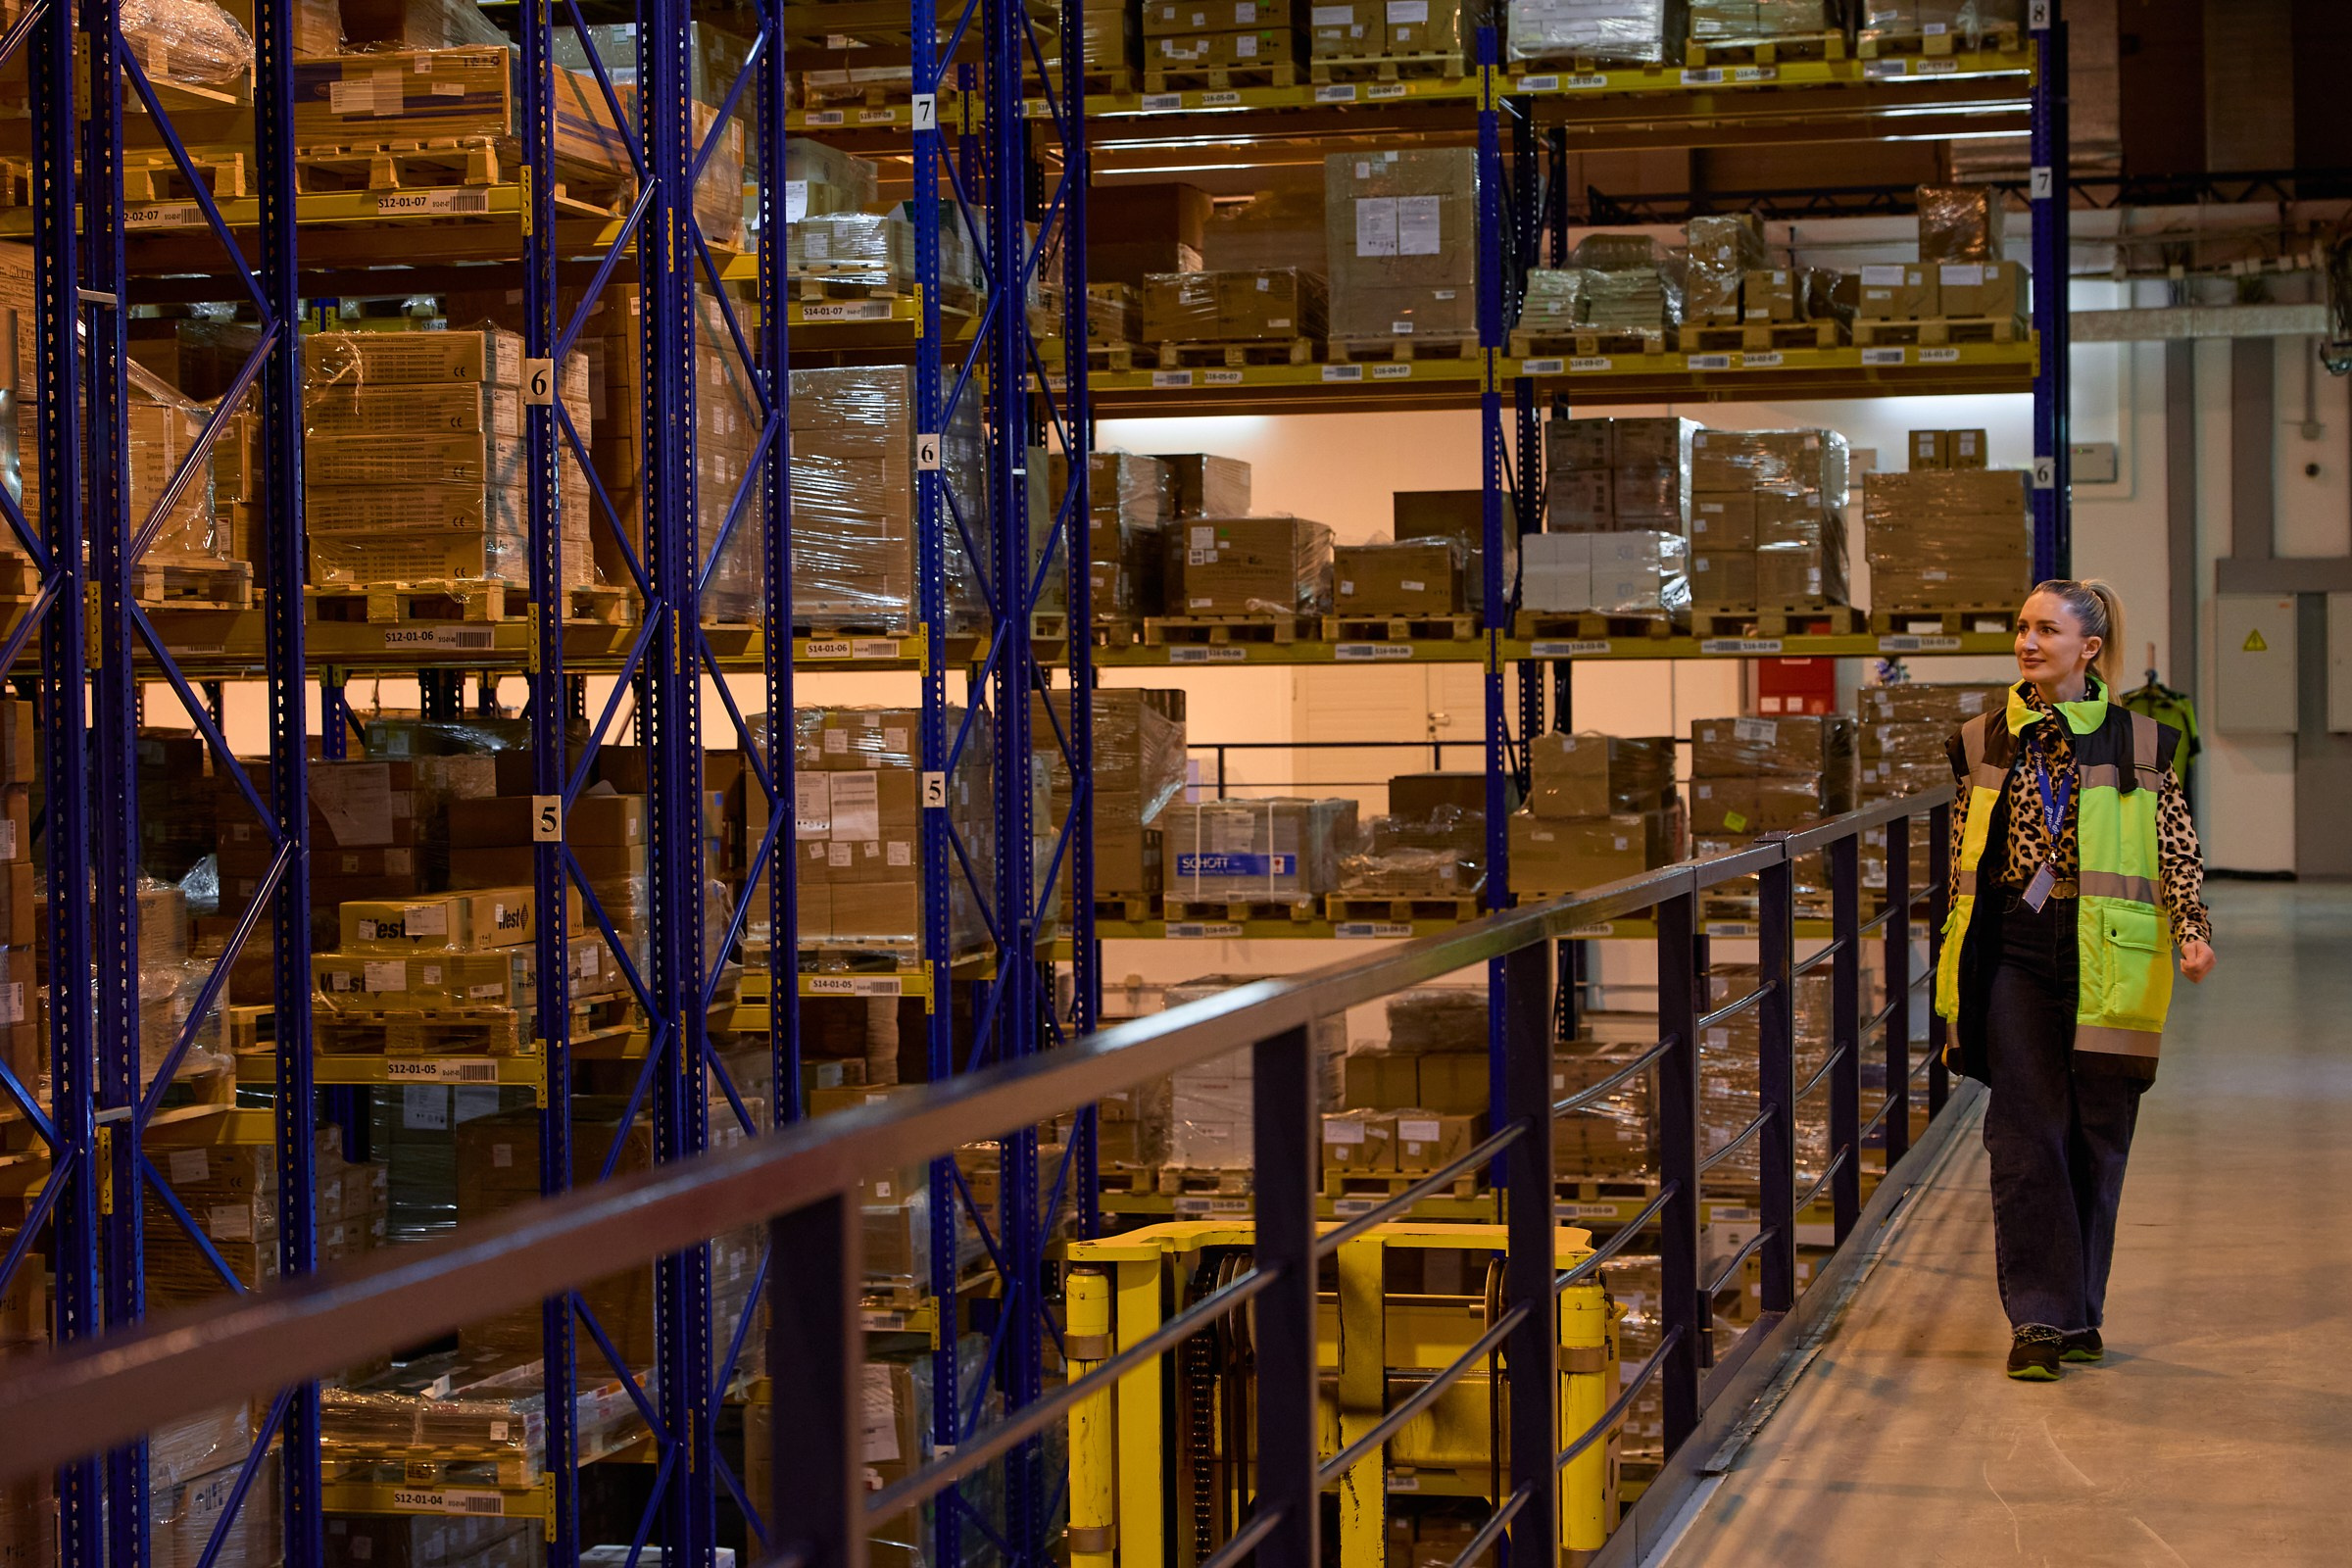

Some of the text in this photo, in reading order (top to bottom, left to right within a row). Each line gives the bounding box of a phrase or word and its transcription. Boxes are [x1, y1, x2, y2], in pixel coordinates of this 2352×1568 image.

[2034, 4, 2045, 23] 8
[918, 101, 931, 122] 7
[2037, 172, 2049, 191] 7
[378, 197, 426, 209] S12-01-07
[123, 211, 159, 221] 2-02-07
[804, 306, 843, 316] S14-01-07
[531, 368, 547, 396] 6
[920, 444, 934, 464] 6
[2037, 465, 2049, 483] 6
[385, 631, 432, 643] S12-01-06
[808, 644, 848, 653] S14-01-06
[928, 779, 943, 801] 5
[540, 806, 558, 833] 5
[812, 980, 853, 989] S14-01-05
[388, 1063, 437, 1074] S12-01-05
[394, 1494, 443, 1505] S12-01-04
